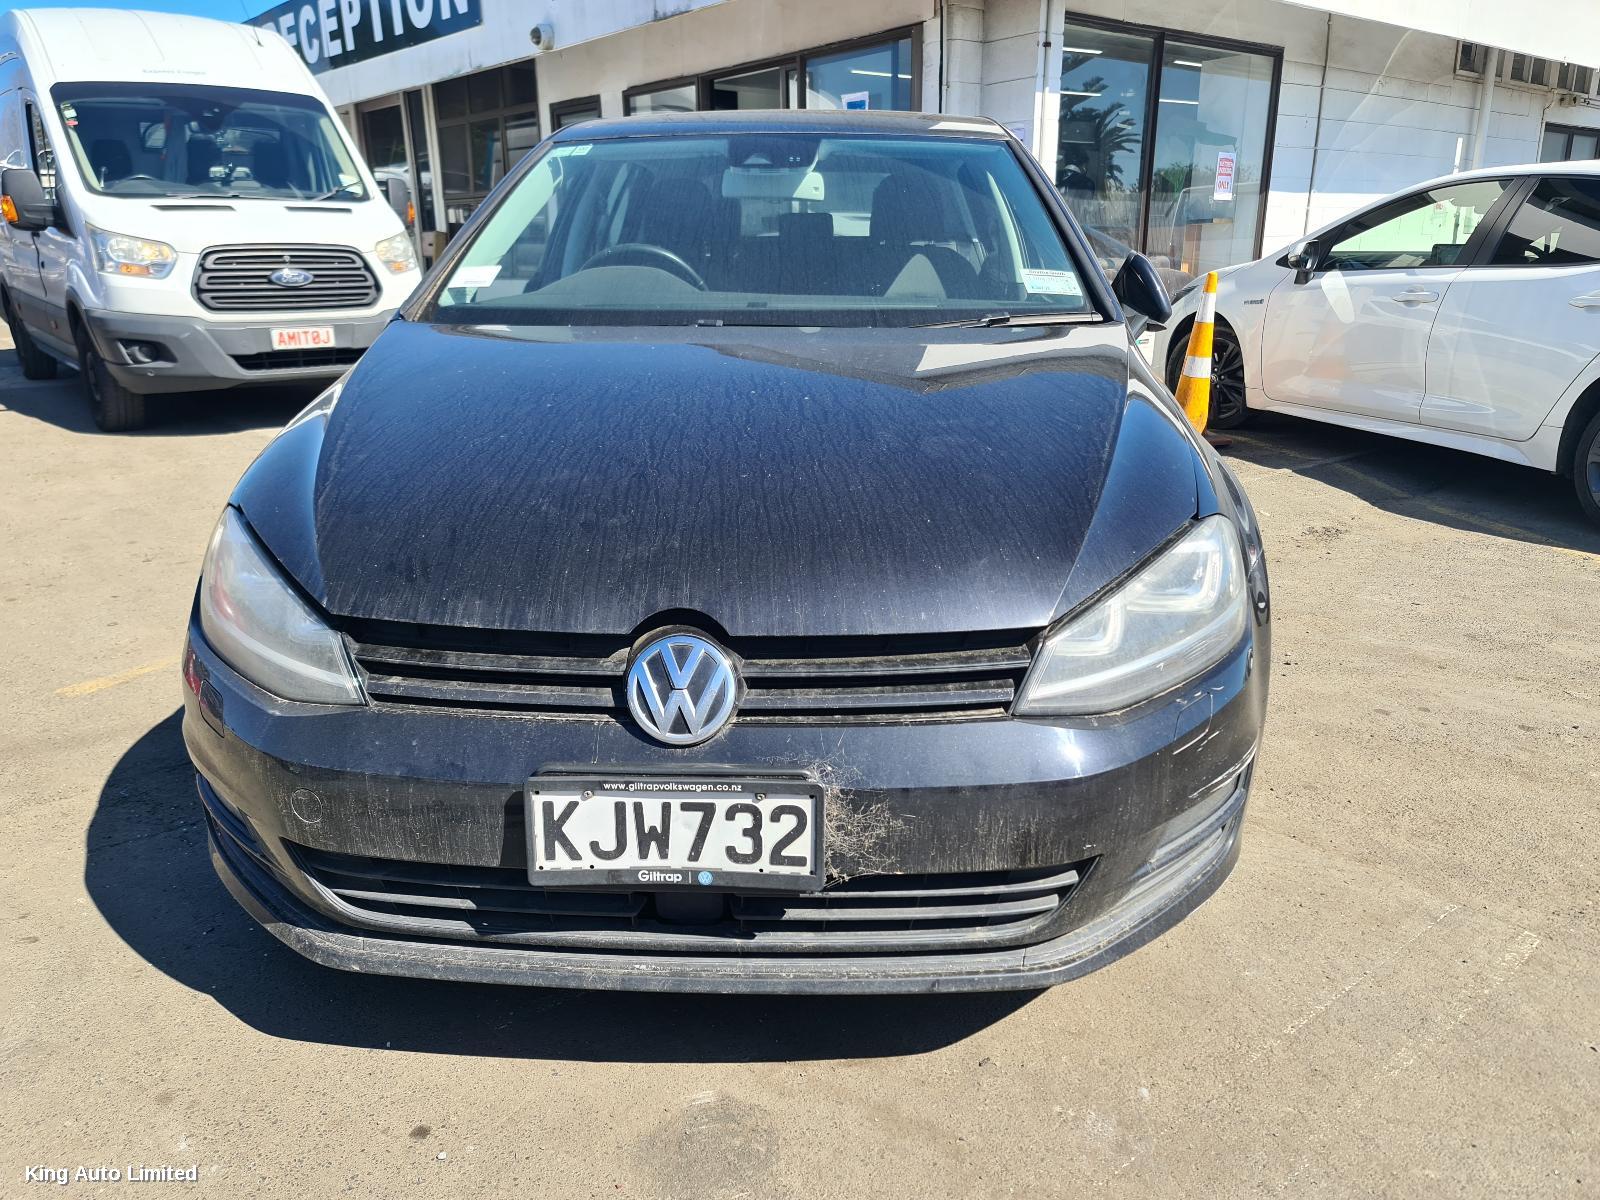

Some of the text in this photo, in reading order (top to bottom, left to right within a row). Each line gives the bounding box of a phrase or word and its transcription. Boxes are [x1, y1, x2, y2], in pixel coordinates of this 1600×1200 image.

[261, 0, 468, 64] ECEPTIO
[603, 782, 743, 793] www.giltrapvolkswagen.co.nz
[542, 800, 808, 867] KJW732
[637, 870, 683, 884] Giltrap
